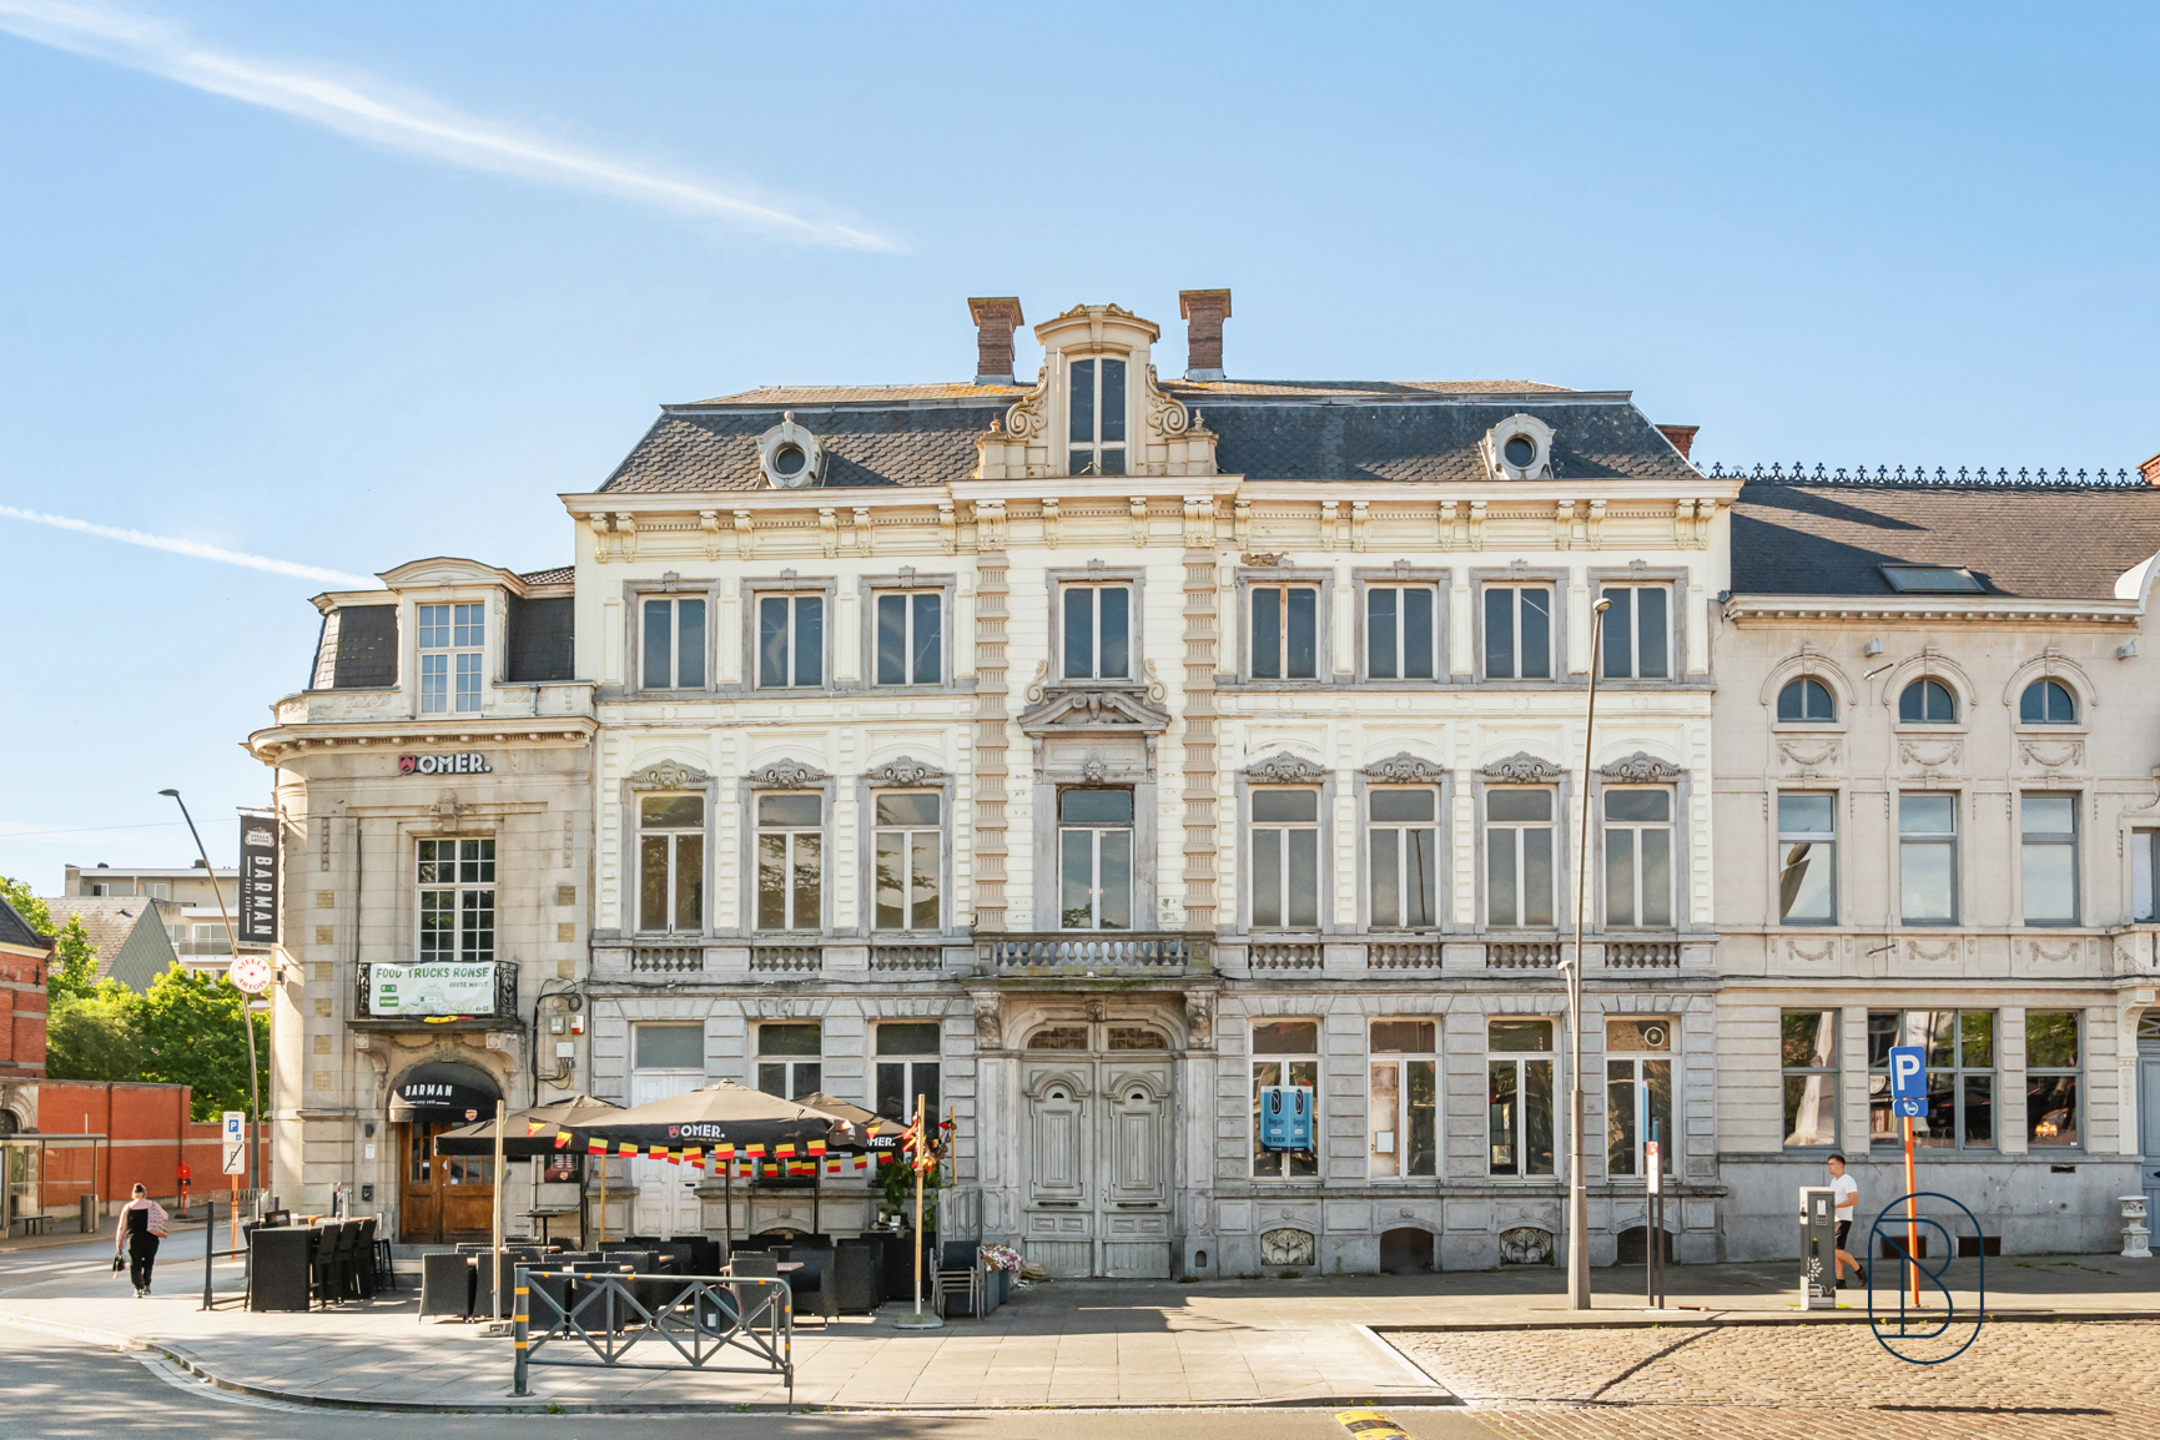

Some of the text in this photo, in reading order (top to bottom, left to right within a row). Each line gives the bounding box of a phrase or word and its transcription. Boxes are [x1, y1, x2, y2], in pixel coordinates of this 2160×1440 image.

[253, 855, 273, 935] BARMAN
[237, 958, 267, 971] STELLA
[376, 967, 490, 978] FOOD TRUCKS RONSE
[237, 978, 267, 990] ARTOIS
[1895, 1054, 1921, 1091] P
[405, 1083, 453, 1097] BARMAN
[230, 1121, 238, 1131] P
